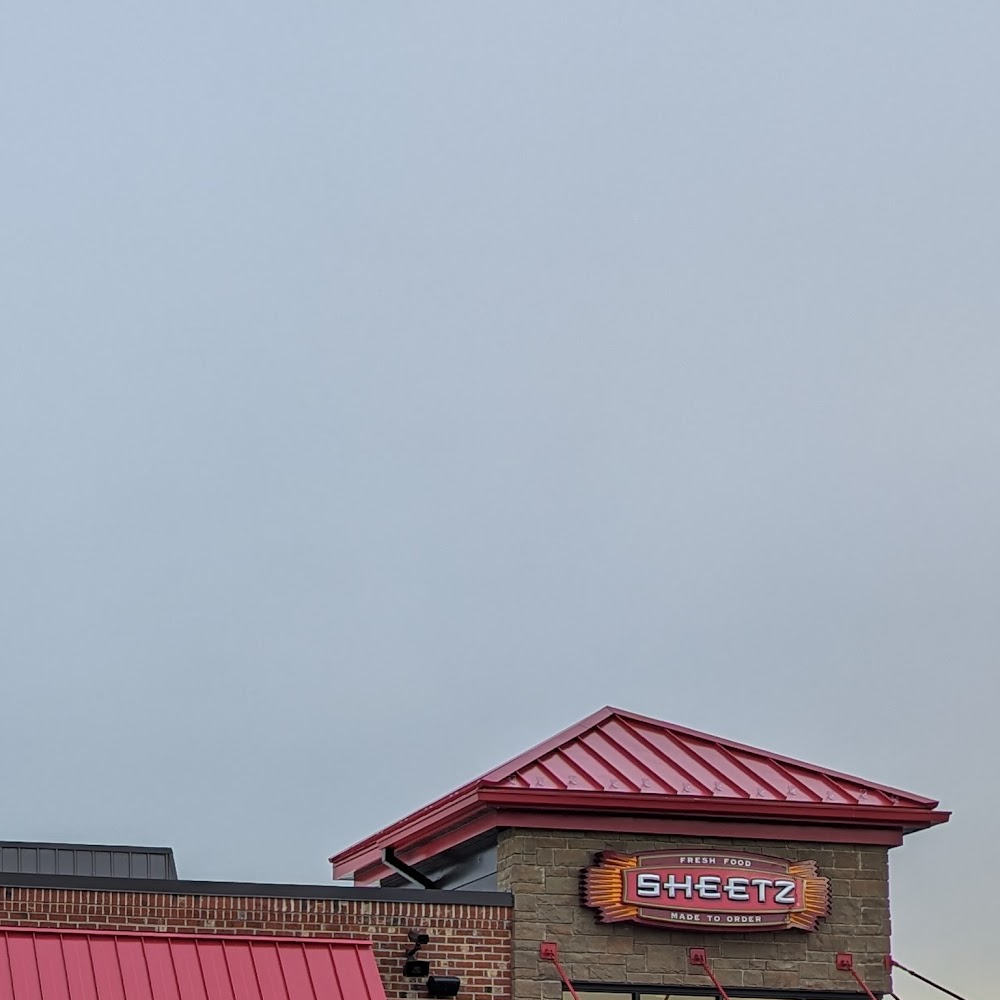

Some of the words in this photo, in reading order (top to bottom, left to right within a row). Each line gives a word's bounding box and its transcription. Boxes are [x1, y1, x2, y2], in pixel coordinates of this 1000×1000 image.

[680, 857, 716, 865] FRESH
[723, 858, 752, 867] FOOD
[636, 873, 796, 904] SHEETZ
[670, 913, 701, 921] MADE
